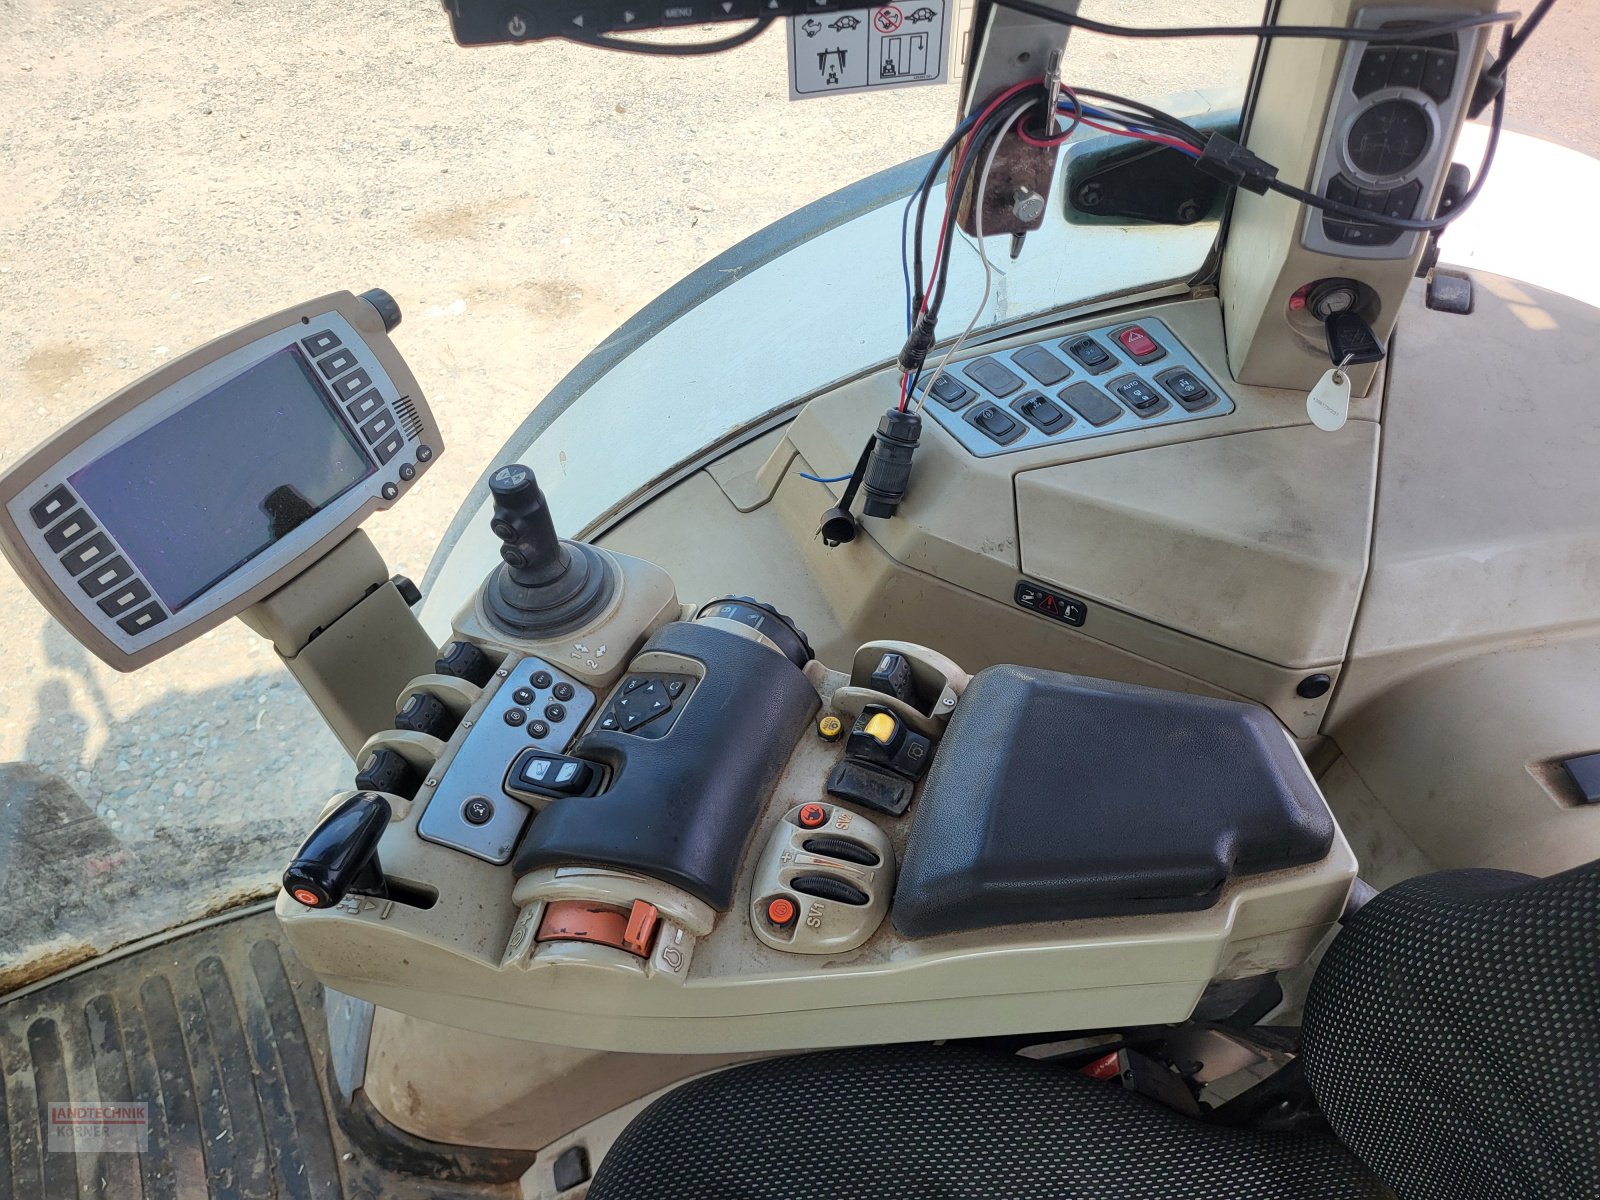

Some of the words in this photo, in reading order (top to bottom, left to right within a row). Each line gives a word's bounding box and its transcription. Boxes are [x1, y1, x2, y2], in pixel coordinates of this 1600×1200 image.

[665, 7, 692, 18] MENU
[1123, 381, 1138, 390] AUTO
[586, 659, 599, 669] 2
[496, 668, 508, 677] 3
[628, 680, 637, 689] OK
[942, 697, 955, 706] 6
[461, 719, 473, 729] 4
[424, 778, 437, 787] 5
[835, 813, 853, 831] SV2
[807, 902, 826, 929] SV1
